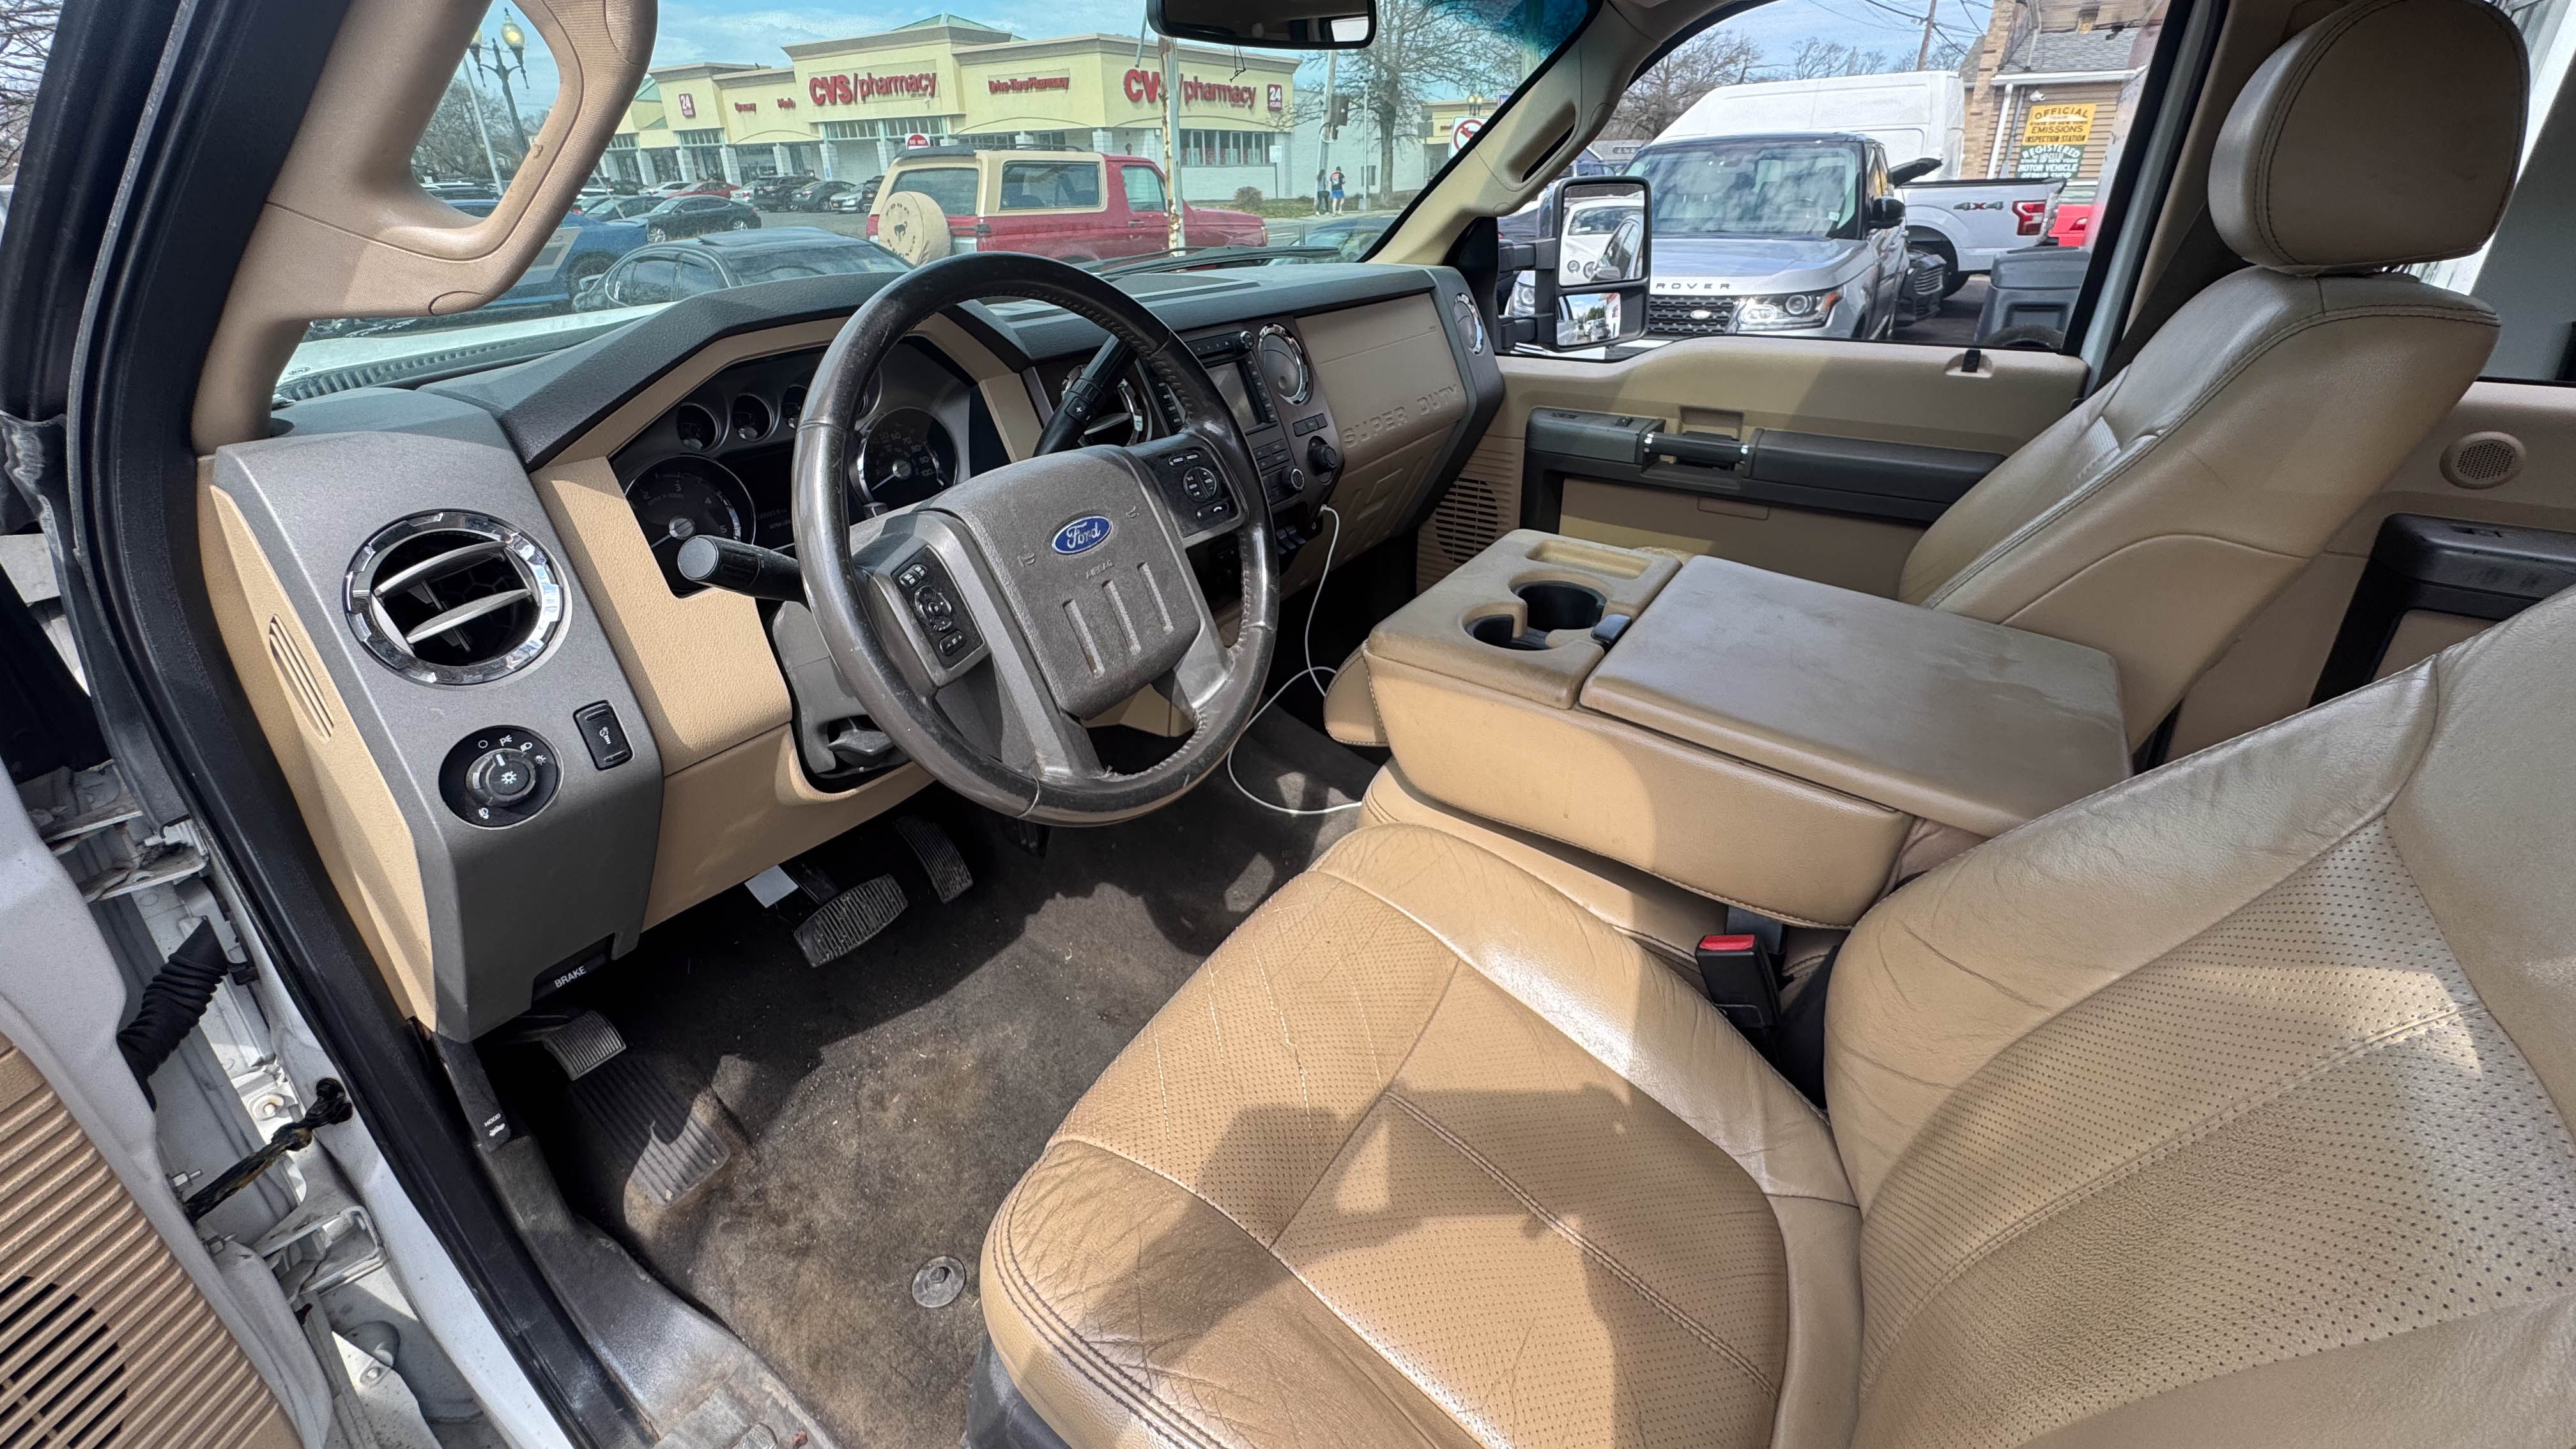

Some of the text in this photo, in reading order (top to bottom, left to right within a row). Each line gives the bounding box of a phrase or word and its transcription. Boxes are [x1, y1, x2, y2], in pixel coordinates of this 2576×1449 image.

[809, 72, 937, 105] CVS/pharmacy
[1124, 68, 1257, 109] CV/pharmacy
[1269, 87, 1282, 101] 24
[680, 95, 692, 109] 24
[2034, 107, 2089, 120] OFFICIAL
[2031, 125, 2083, 134] EMISSIONS
[2021, 144, 2081, 159] REGISTERED
[2045, 164, 2078, 172] VEHICLE
[1343, 383, 1457, 448] SUPER DUTY
[674, 483, 682, 492] 3
[643, 491, 651, 500] 2
[705, 496, 712, 505] 4
[720, 525, 728, 533] 5
[1066, 521, 1101, 549] Ford
[1086, 560, 1115, 579] AIRBAG
[554, 965, 586, 988] BRAKE
[484, 1113, 502, 1127] HOOD
